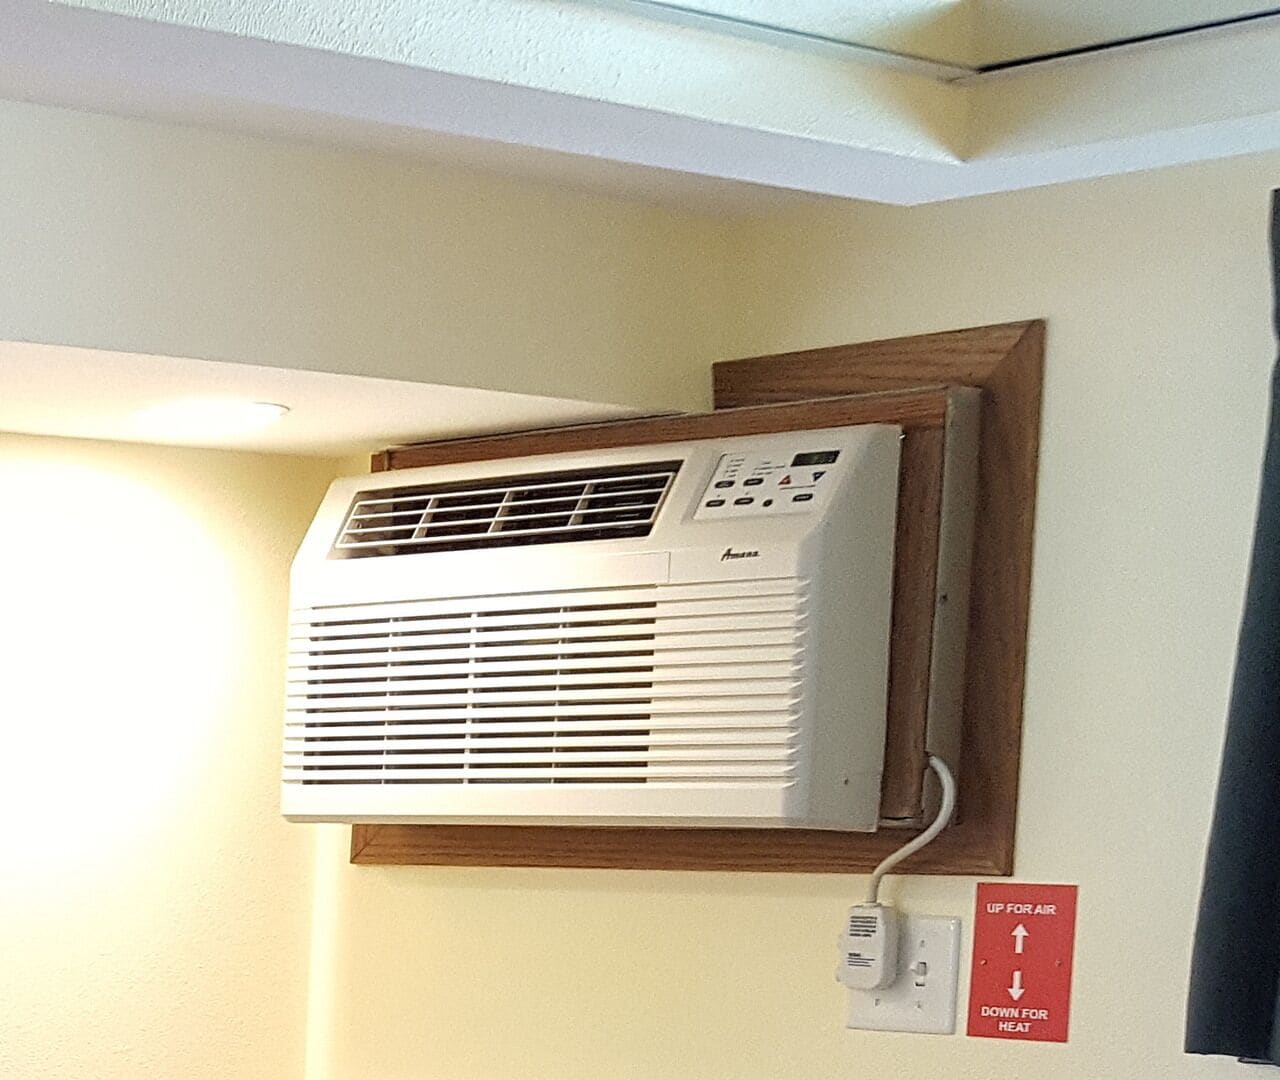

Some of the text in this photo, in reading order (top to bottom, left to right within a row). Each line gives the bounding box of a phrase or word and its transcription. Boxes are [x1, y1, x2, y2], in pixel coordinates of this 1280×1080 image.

[720, 548, 760, 561] Amana
[986, 903, 1057, 915] UP FOR AIR
[981, 1006, 1049, 1020] DOWN FOR
[998, 1021, 1032, 1033] HEAT
